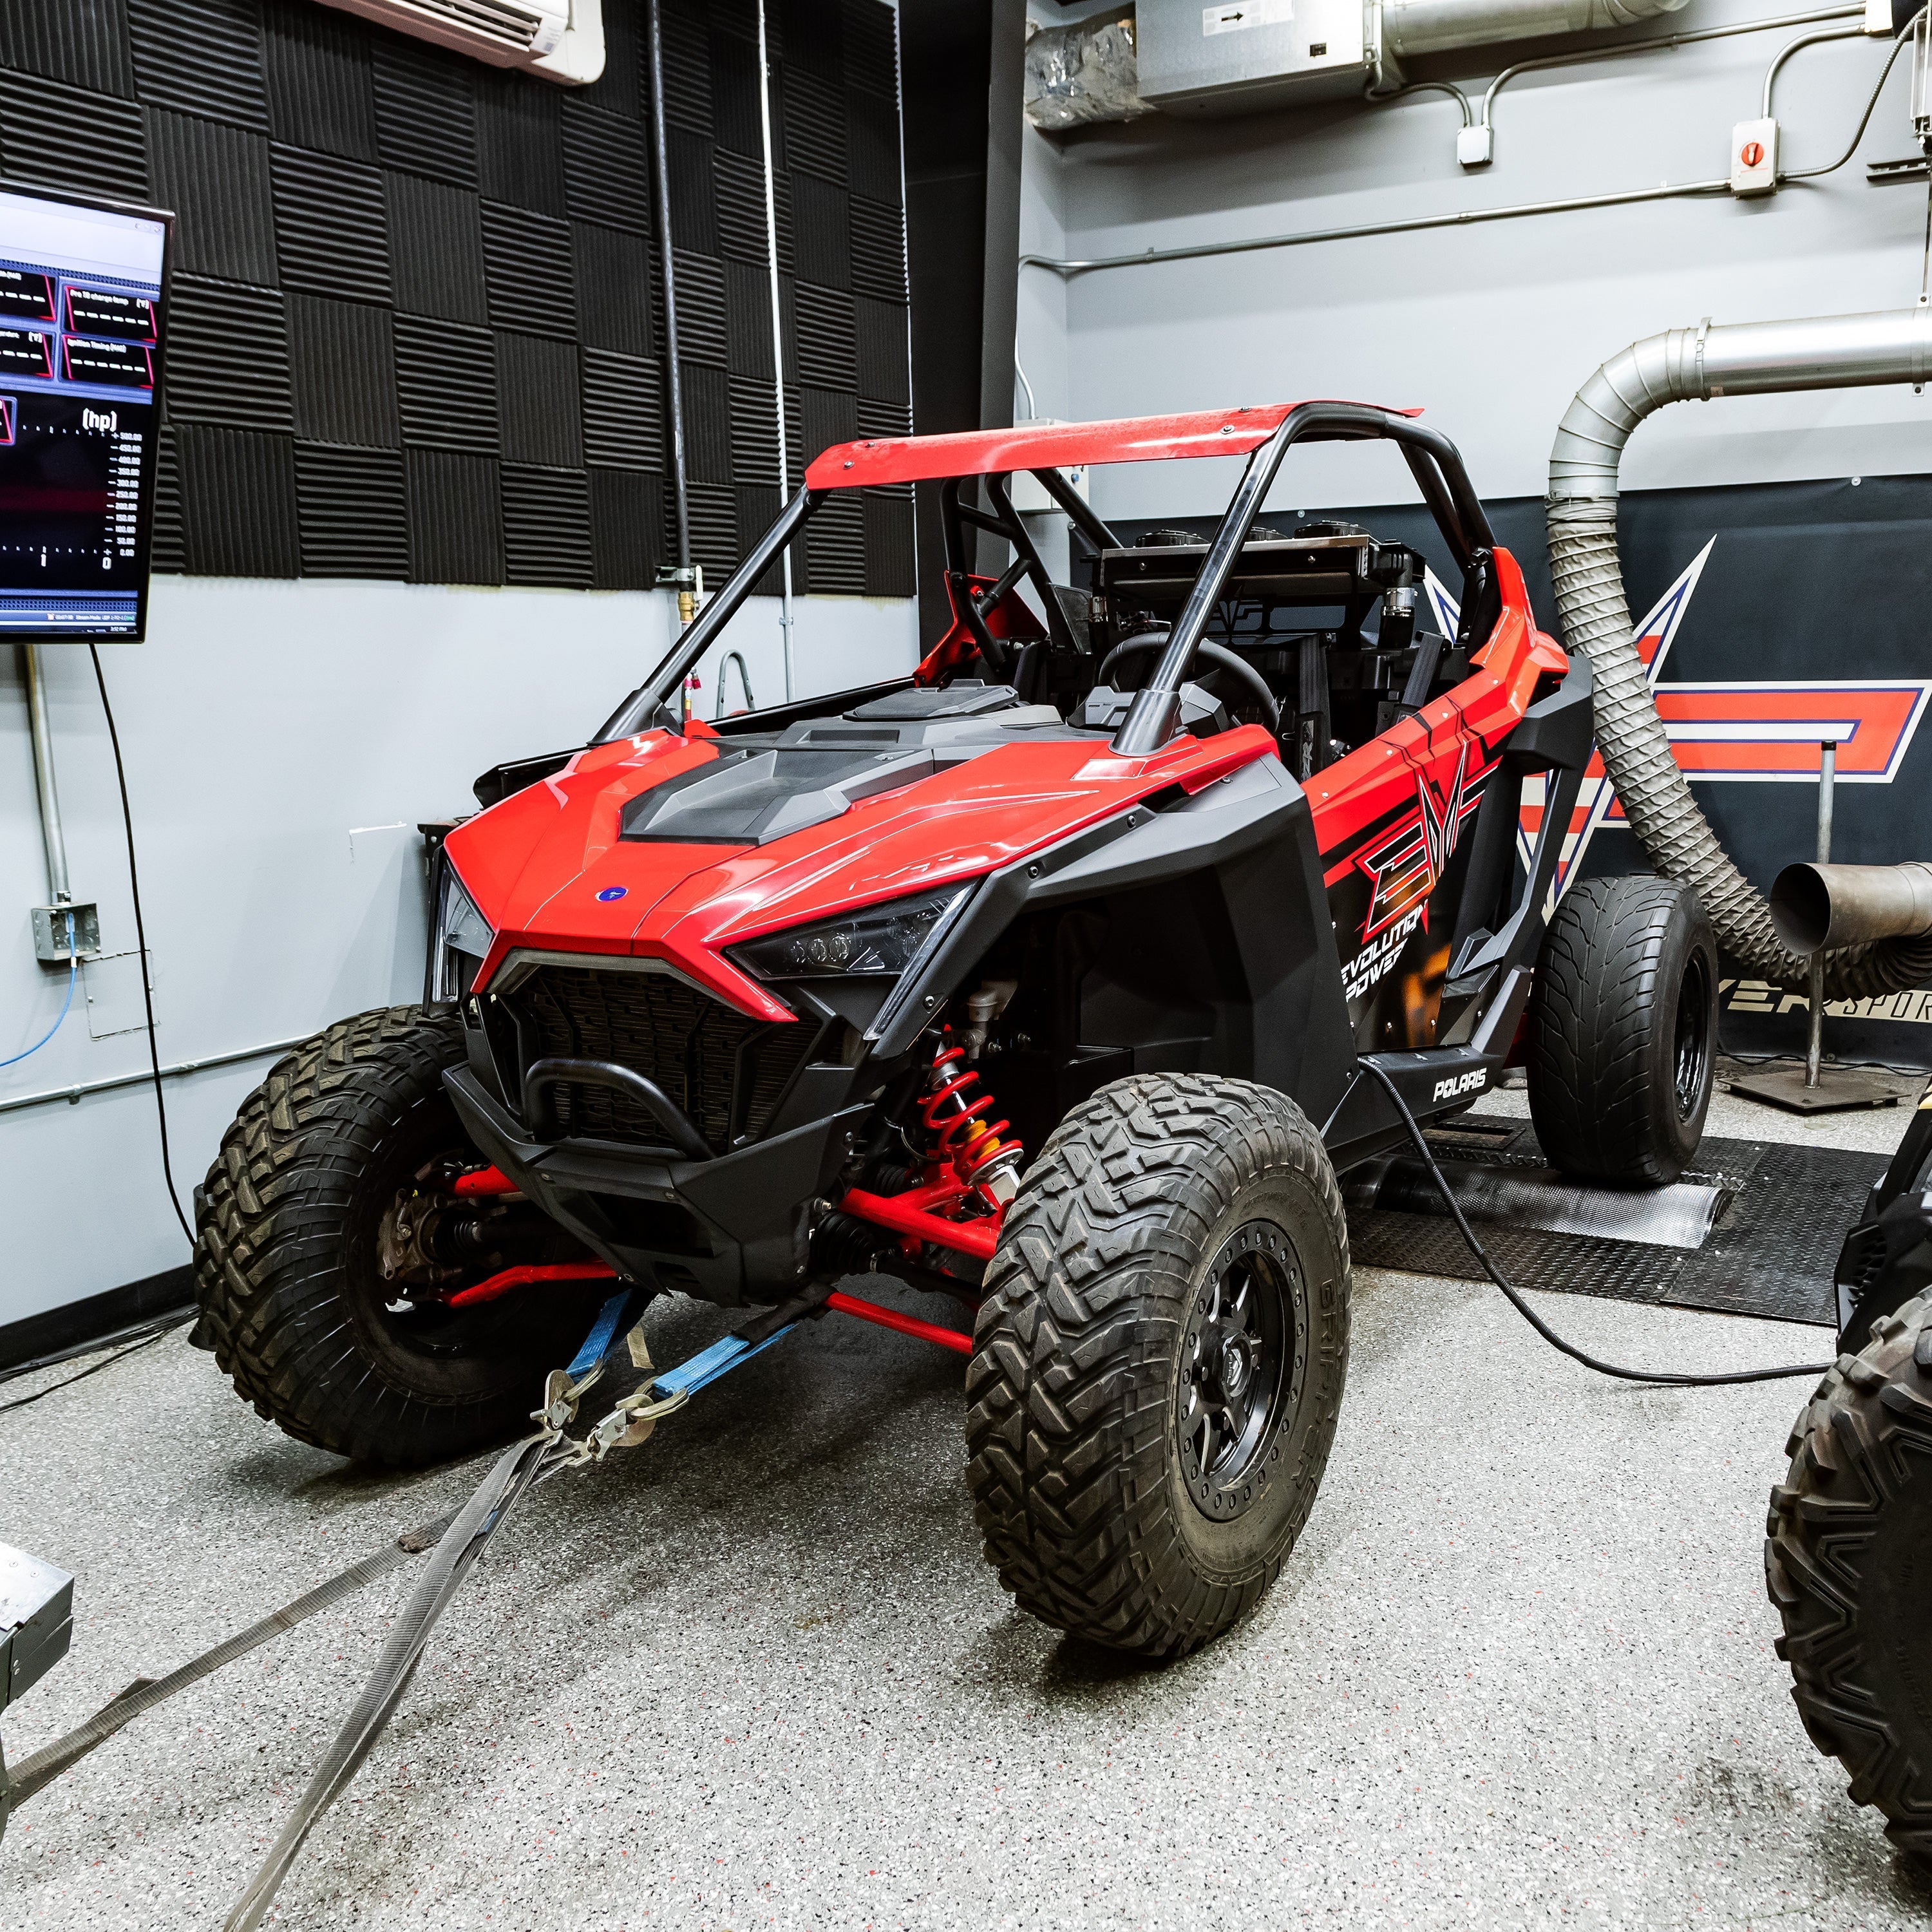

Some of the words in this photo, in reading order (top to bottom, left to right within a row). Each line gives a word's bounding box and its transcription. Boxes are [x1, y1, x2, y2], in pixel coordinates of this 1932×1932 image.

[82, 408, 117, 432] (hp)
[102, 557, 111, 570] 0
[1433, 1067, 1487, 1103] POLARIS
